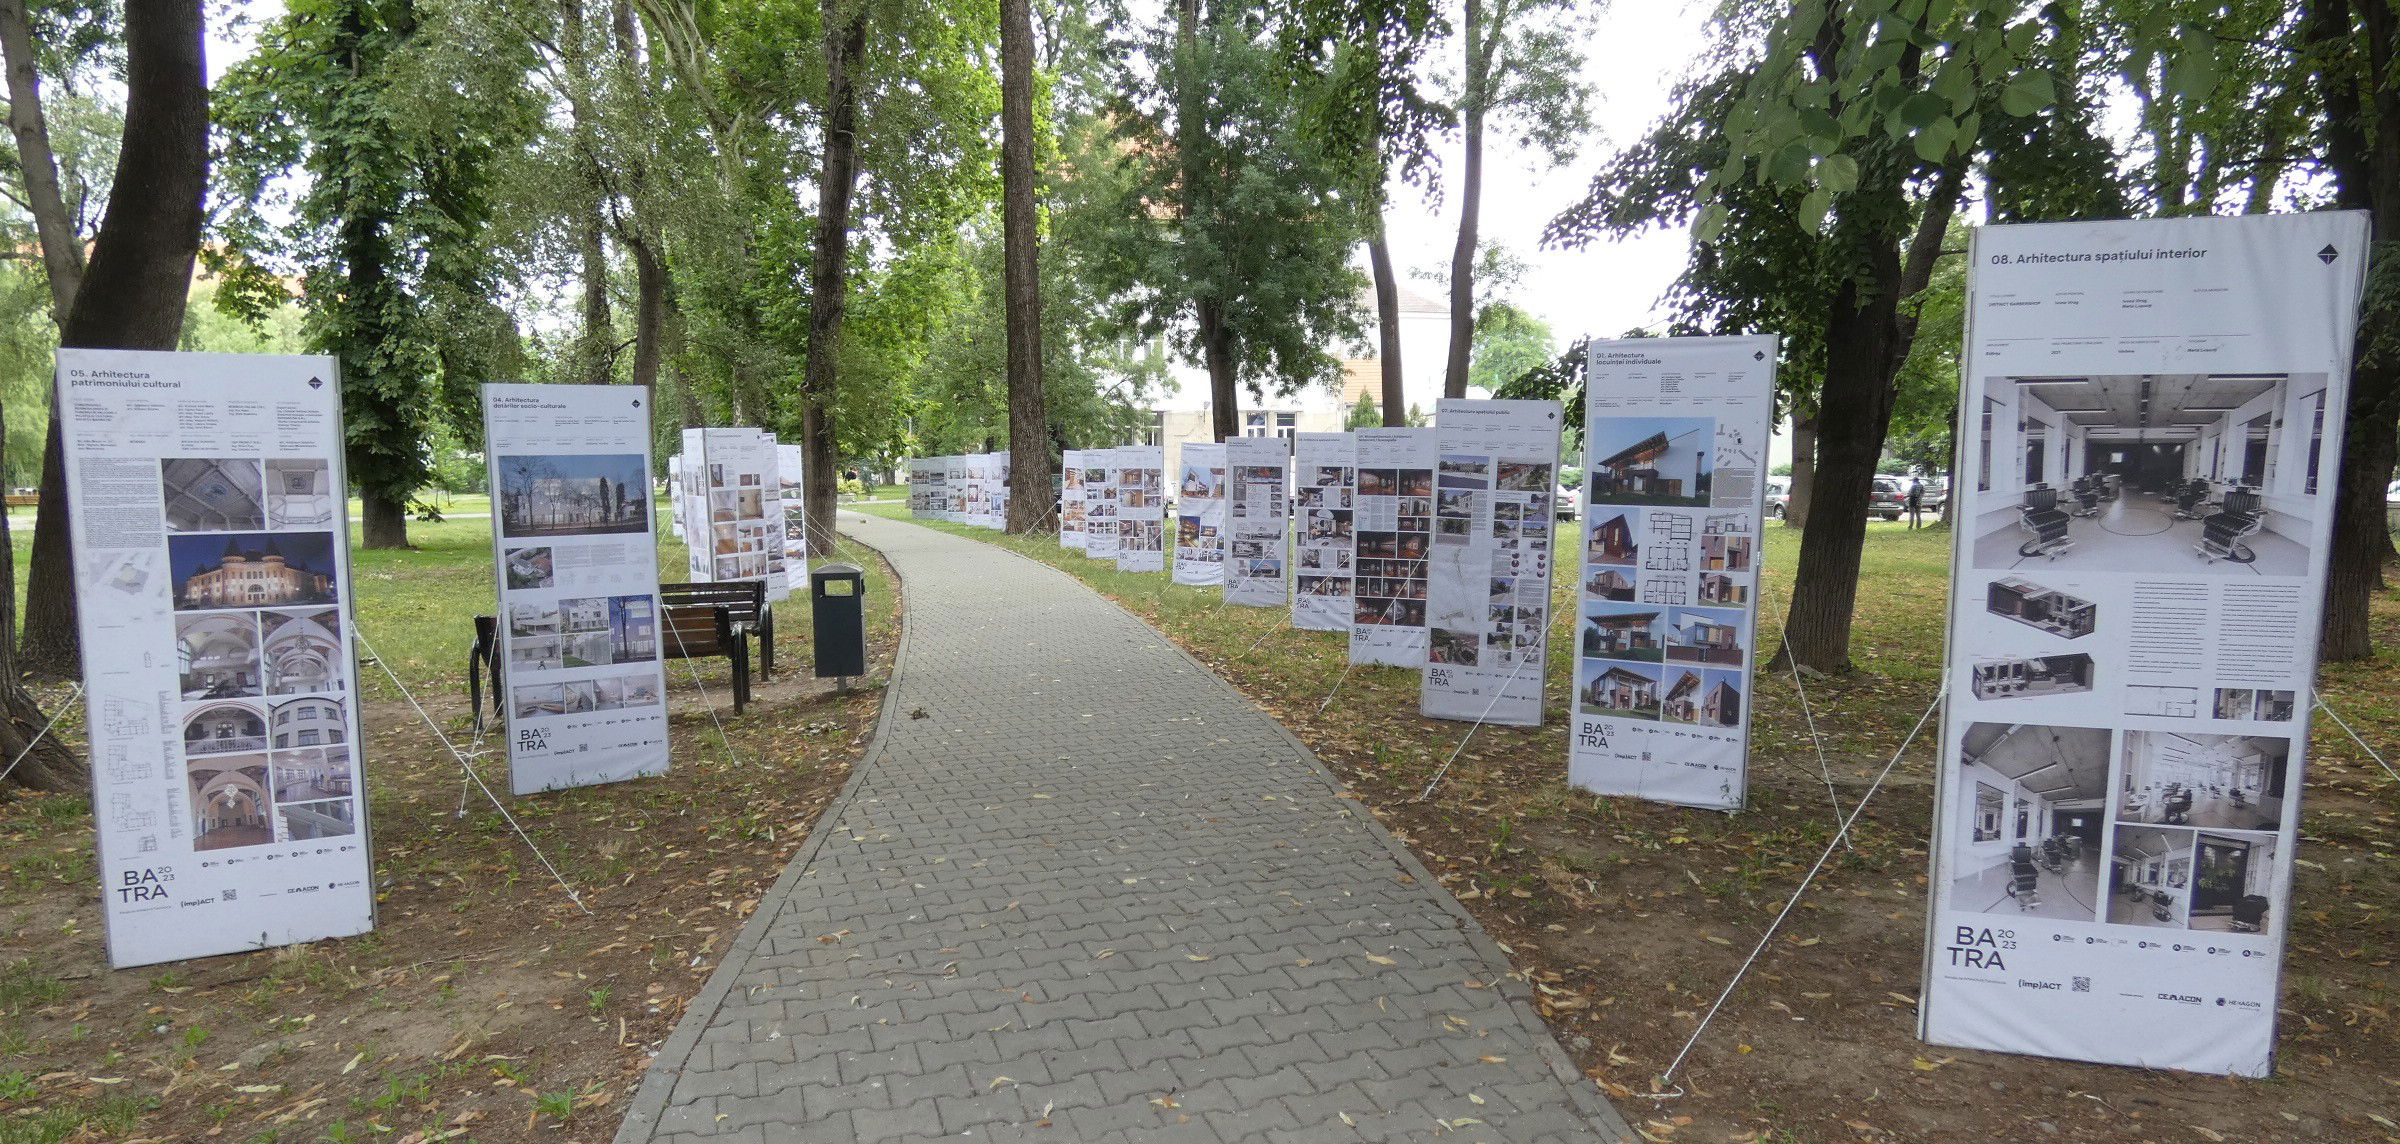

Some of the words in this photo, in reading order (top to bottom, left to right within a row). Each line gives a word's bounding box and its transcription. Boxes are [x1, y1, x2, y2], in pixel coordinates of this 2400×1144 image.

[1991, 254, 2013, 264] 08.
[2016, 252, 2091, 264] Arhitectura
[2094, 249, 2153, 264] spațiului
[2156, 247, 2207, 260] interior
[70, 369, 88, 378] 05.
[91, 370, 150, 379] Arhitectura
[71, 379, 140, 388] patrimoniului
[142, 380, 181, 388] cultural
[504, 396, 540, 404] Arhitectura
[1356, 627, 1367, 635] BA
[1354, 634, 1369, 642] TRA
[1431, 668, 1446, 677] BA
[1428, 676, 1450, 687] TRA
[520, 728, 542, 741] BA
[1583, 722, 1604, 736] BA
[516, 739, 548, 752] TRA
[1578, 734, 1609, 749] TRA
[124, 868, 158, 886] BA
[158, 866, 172, 874] 20
[117, 884, 169, 903] TRA
[1956, 925, 1997, 948] BA
[1997, 929, 2015, 938] 20
[2002, 940, 2017, 950] 23
[1946, 946, 2006, 971] TRA
